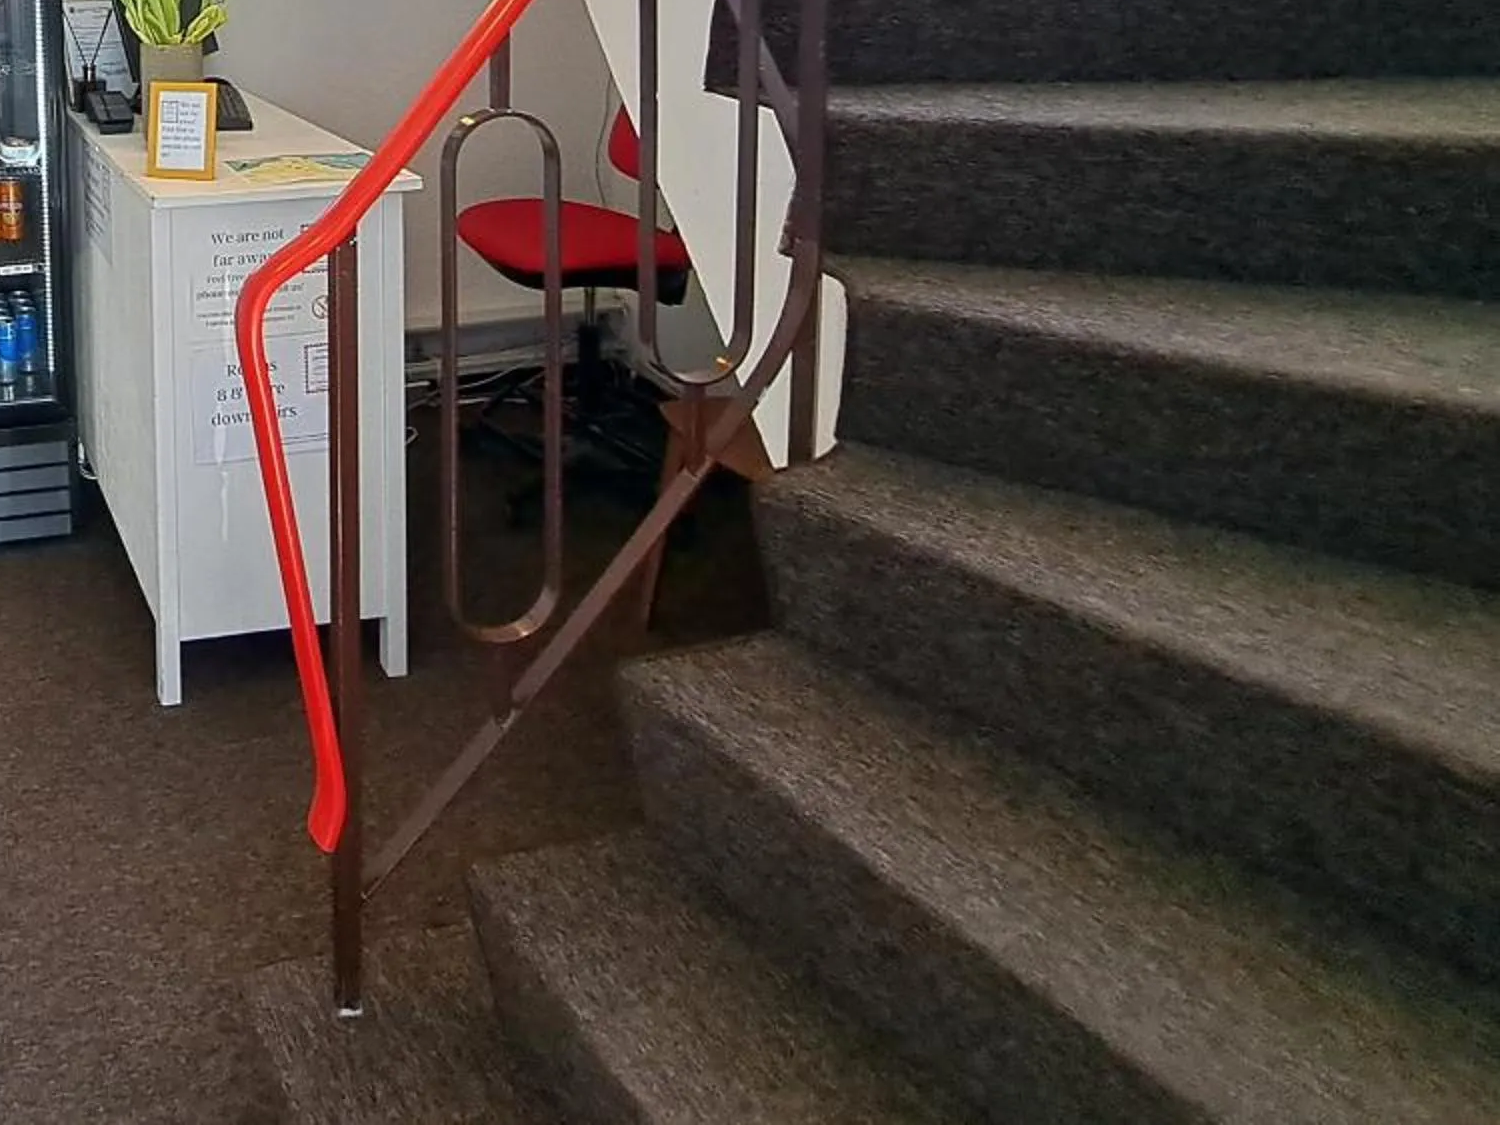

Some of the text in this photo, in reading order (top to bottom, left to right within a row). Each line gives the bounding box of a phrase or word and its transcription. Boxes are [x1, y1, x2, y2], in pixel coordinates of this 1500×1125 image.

[211, 229, 285, 244] We are not
[213, 255, 235, 268] far
